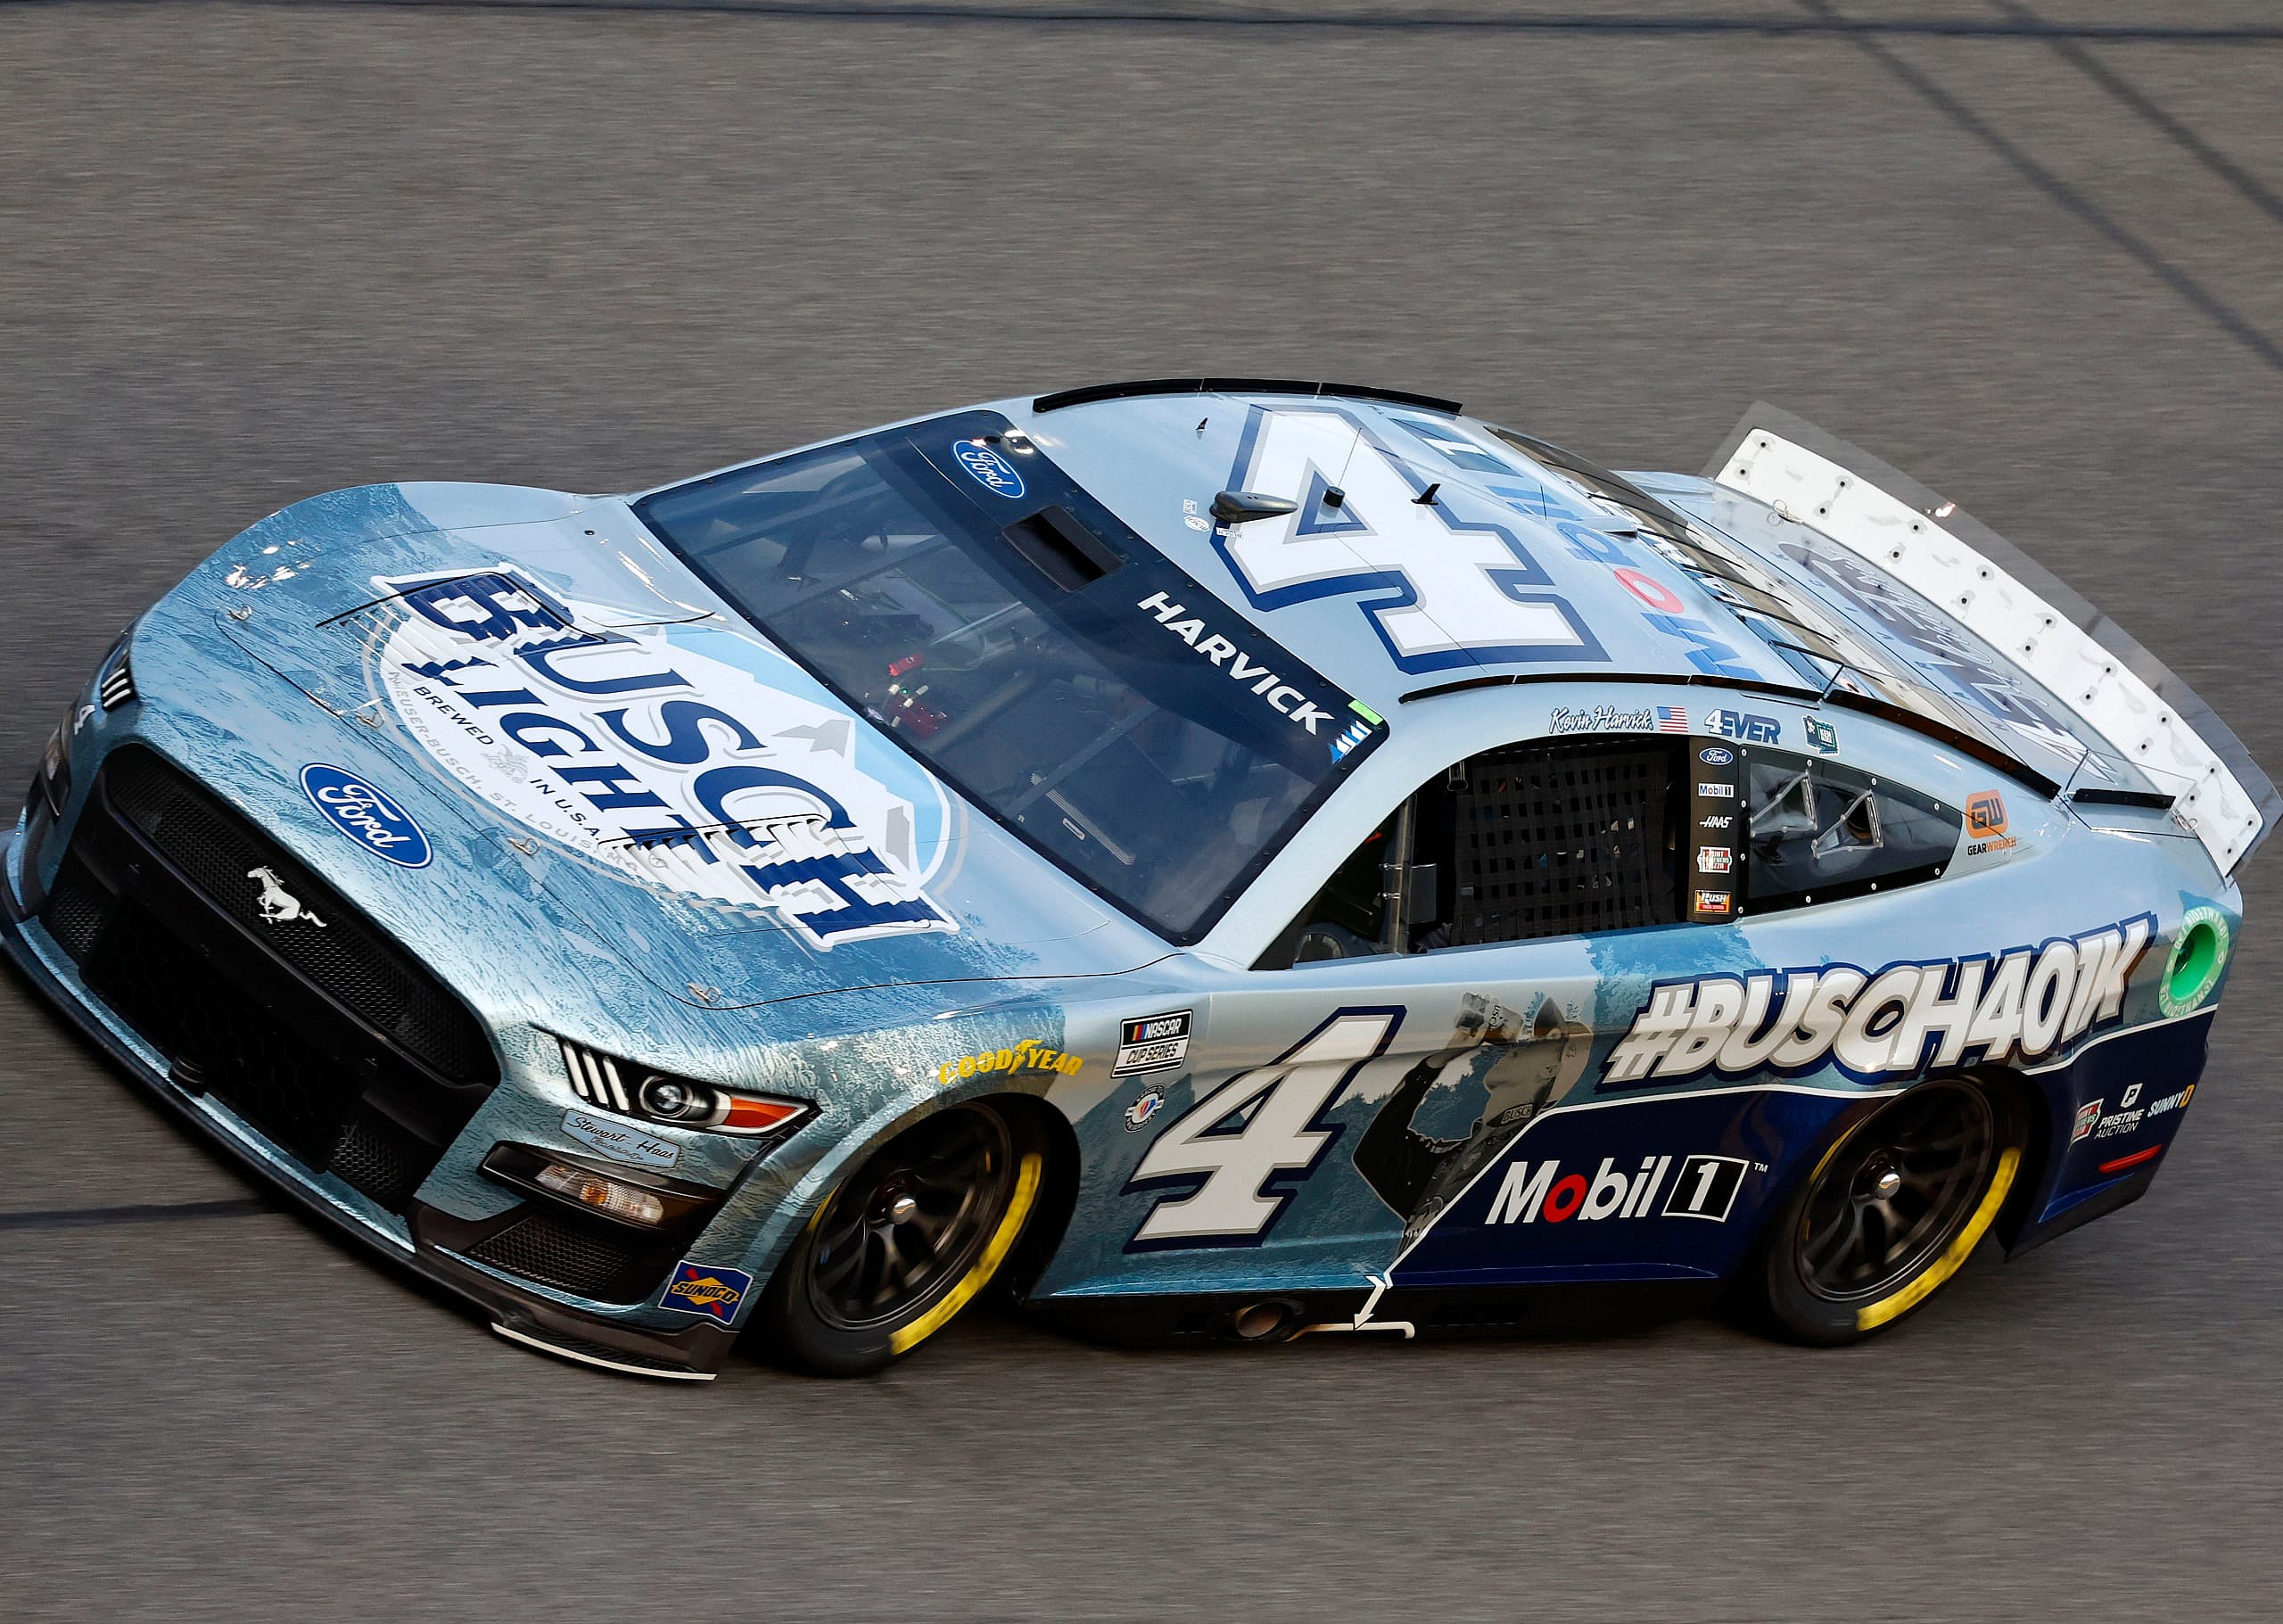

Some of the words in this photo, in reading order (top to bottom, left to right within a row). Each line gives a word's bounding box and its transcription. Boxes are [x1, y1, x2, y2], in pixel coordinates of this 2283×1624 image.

[960, 451, 1014, 488] Ford
[1210, 404, 1612, 675] 4
[1487, 484, 1766, 683] Mobil
[1138, 591, 1335, 737] HARVICK
[1549, 707, 1592, 734] Kevin
[1592, 705, 1654, 731] Harvick
[1704, 710, 1782, 745] 4EVER
[389, 571, 947, 940] BUSCH
[401, 655, 723, 864] LIGHT
[413, 686, 495, 746] BREWED
[530, 779, 556, 796] IN
[555, 798, 600, 841] U.S.A.
[489, 792, 516, 812] ST.
[1699, 785, 1724, 796] Mobil
[317, 784, 411, 848] Ford
[1967, 837, 2016, 856] GEARWRENCH
[1701, 893, 1727, 904] RUSH
[1600, 916, 2155, 1087] #BUSCH401K
[1145, 1018, 1183, 1037] NASCAR
[938, 1039, 1084, 1085] GOODYEAR
[1126, 1046, 1145, 1065] CUP
[1145, 1043, 1179, 1061] SERIES
[1121, 1004, 1406, 1254] 4
[1503, 1105, 1532, 1123] BUSCH
[2094, 1122, 2139, 1140] AUCTION
[2098, 1109, 2145, 1129] PRISTINE
[1485, 1156, 1673, 1225] Mobil
[673, 1282, 740, 1303] SUNOCO
